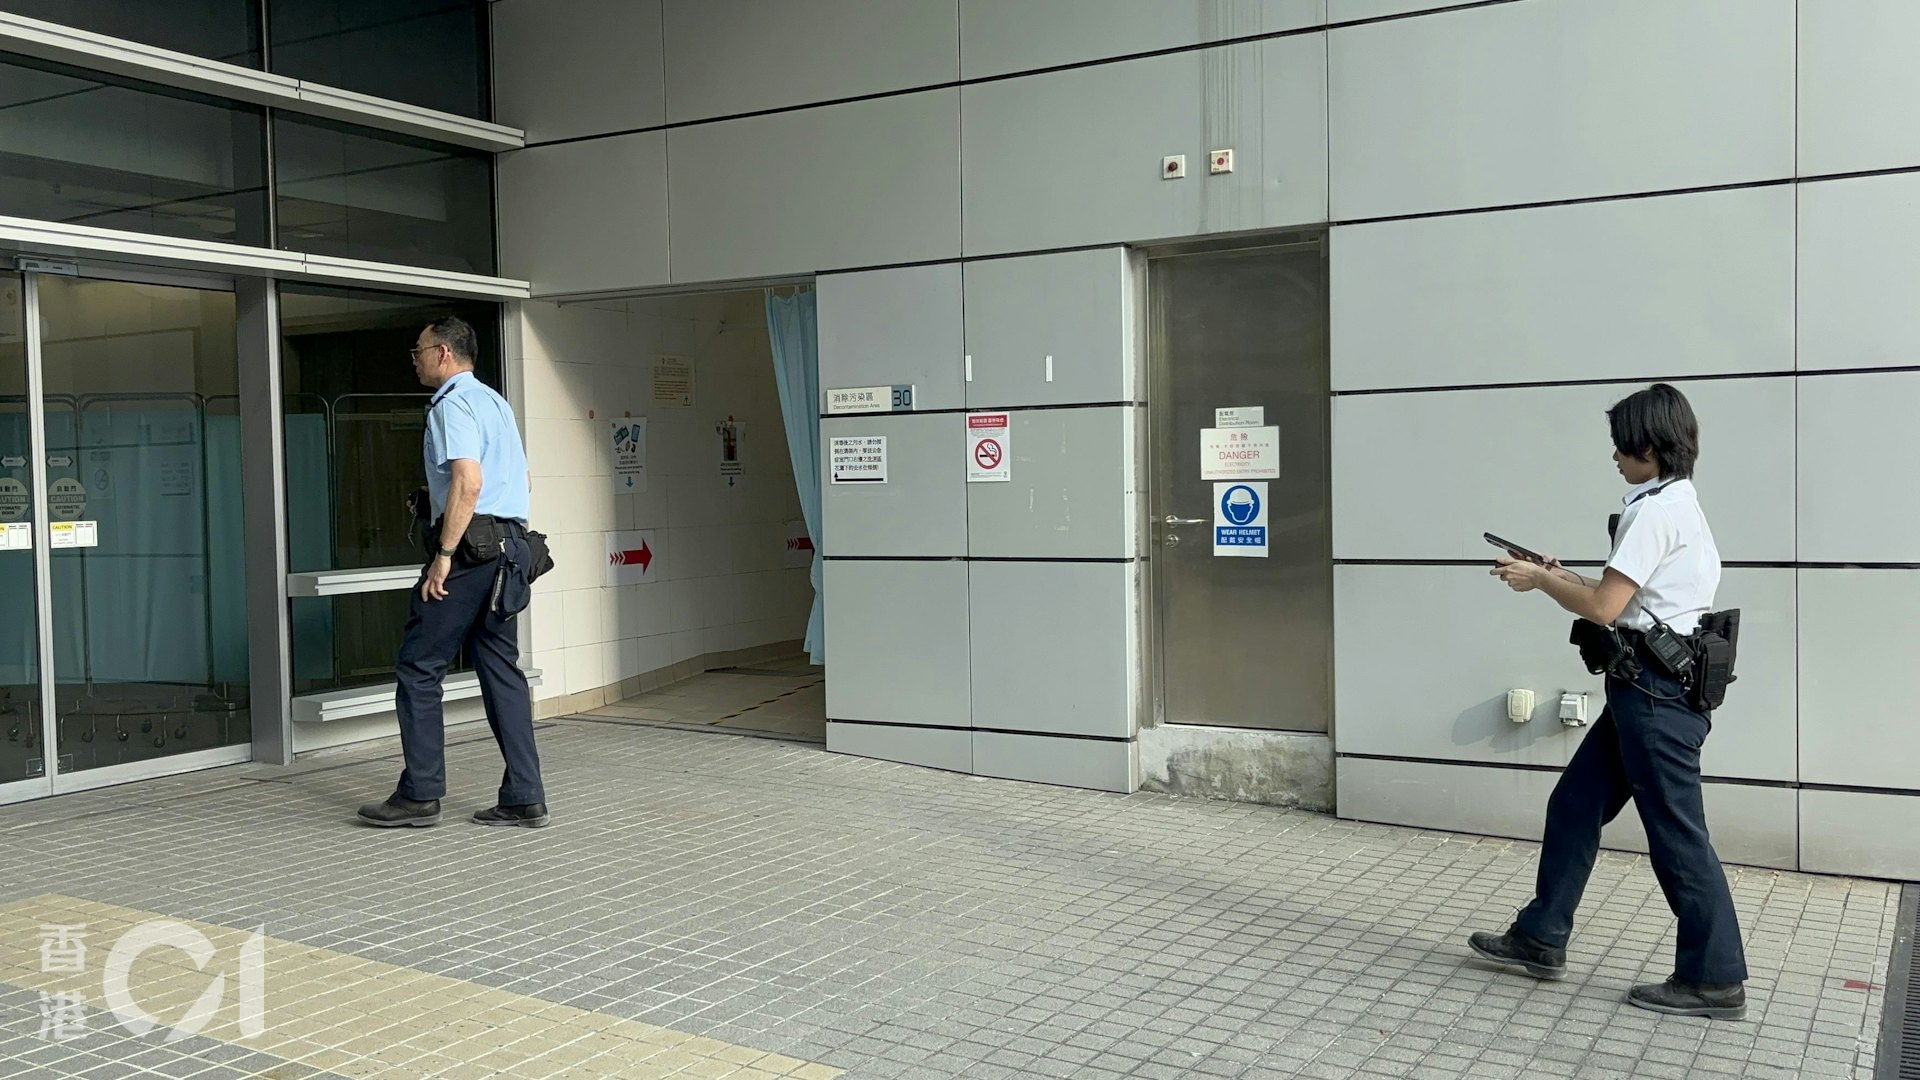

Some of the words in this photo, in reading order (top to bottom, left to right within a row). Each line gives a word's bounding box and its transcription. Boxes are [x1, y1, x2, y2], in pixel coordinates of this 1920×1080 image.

[833, 392, 874, 403] 消除污染區
[893, 390, 912, 407] 30
[1219, 450, 1260, 460] DANGER
[51, 495, 84, 503] CAUTION
